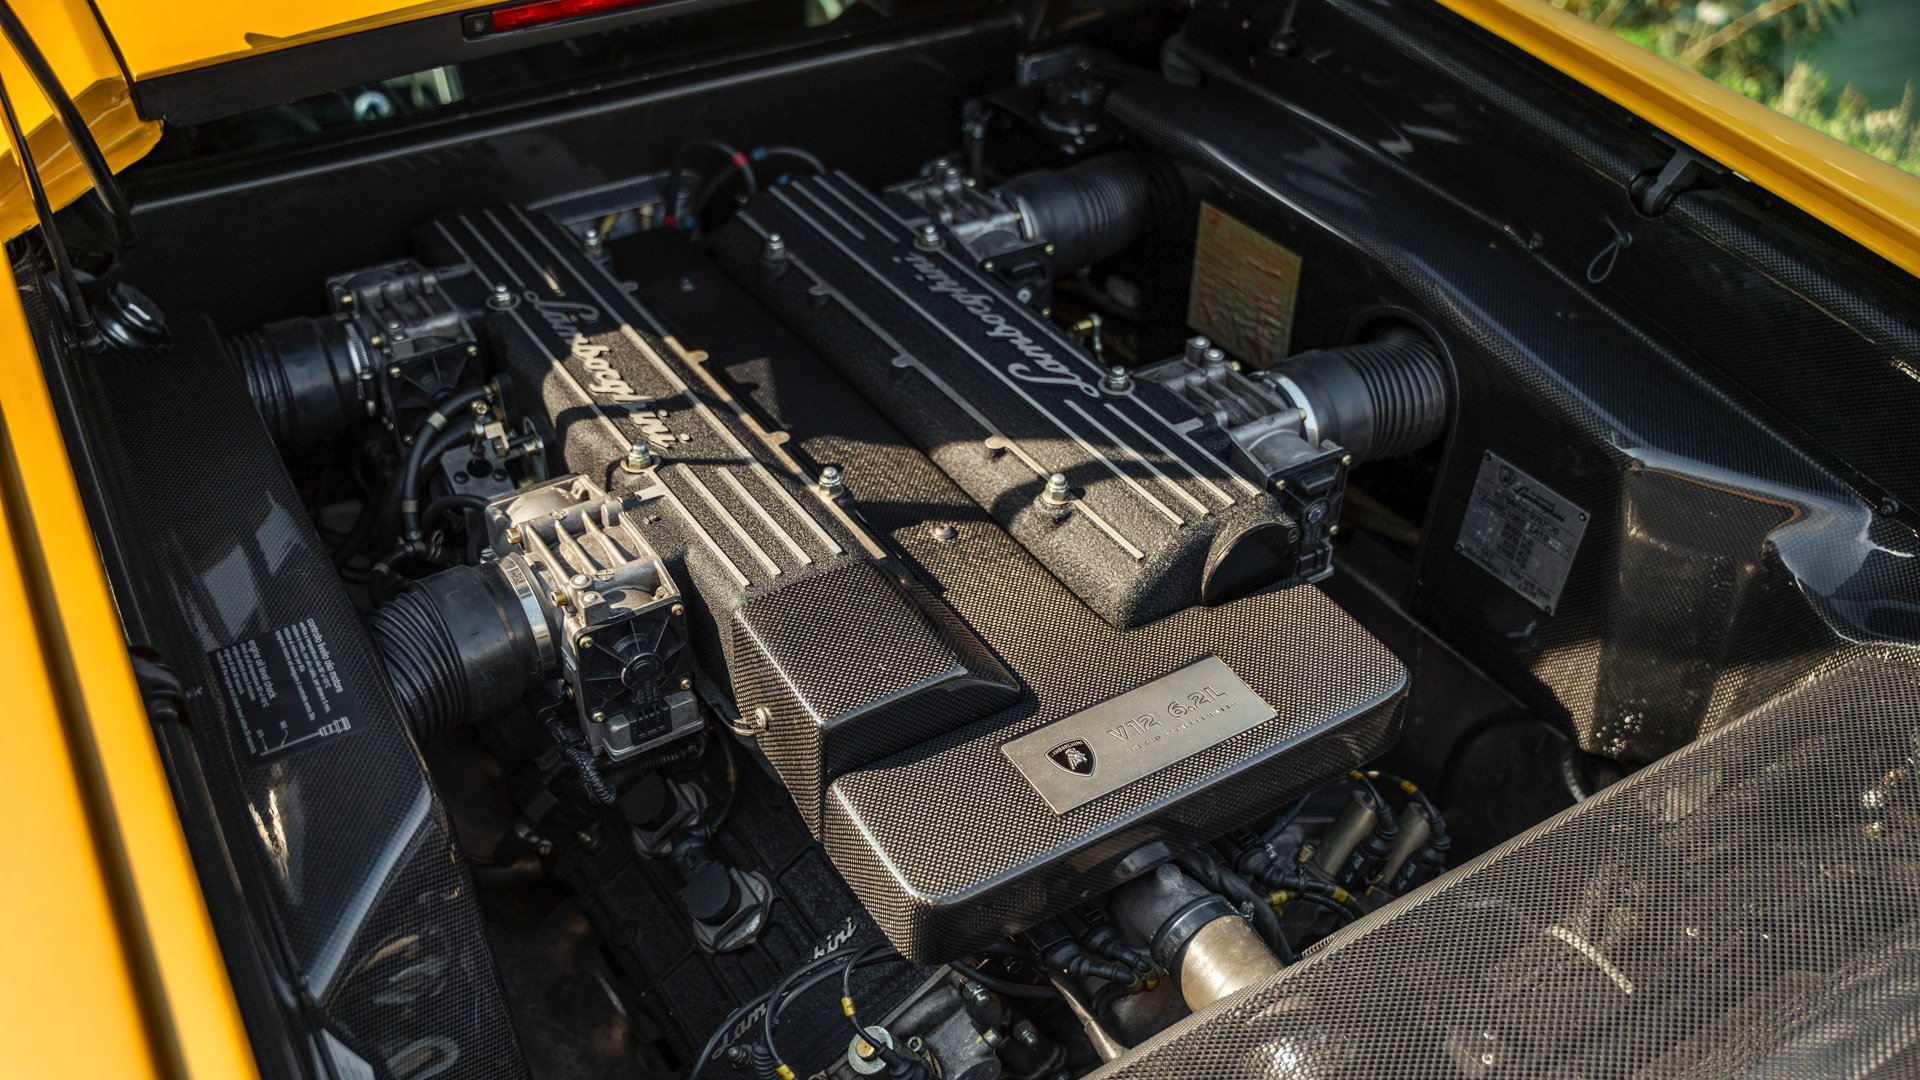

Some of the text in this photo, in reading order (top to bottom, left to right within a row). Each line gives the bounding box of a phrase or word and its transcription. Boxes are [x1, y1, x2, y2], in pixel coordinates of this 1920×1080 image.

[892, 251, 1100, 398] Lamborghini
[524, 290, 692, 450] Lamborghini
[247, 639, 260, 659] engine
[258, 665, 271, 681] level
[306, 618, 343, 692] controllo livello olio motore
[263, 680, 277, 699] check
[1107, 713, 1162, 743] V12
[1167, 686, 1228, 718] 6.2L
[712, 917, 856, 1060] Lamhini
